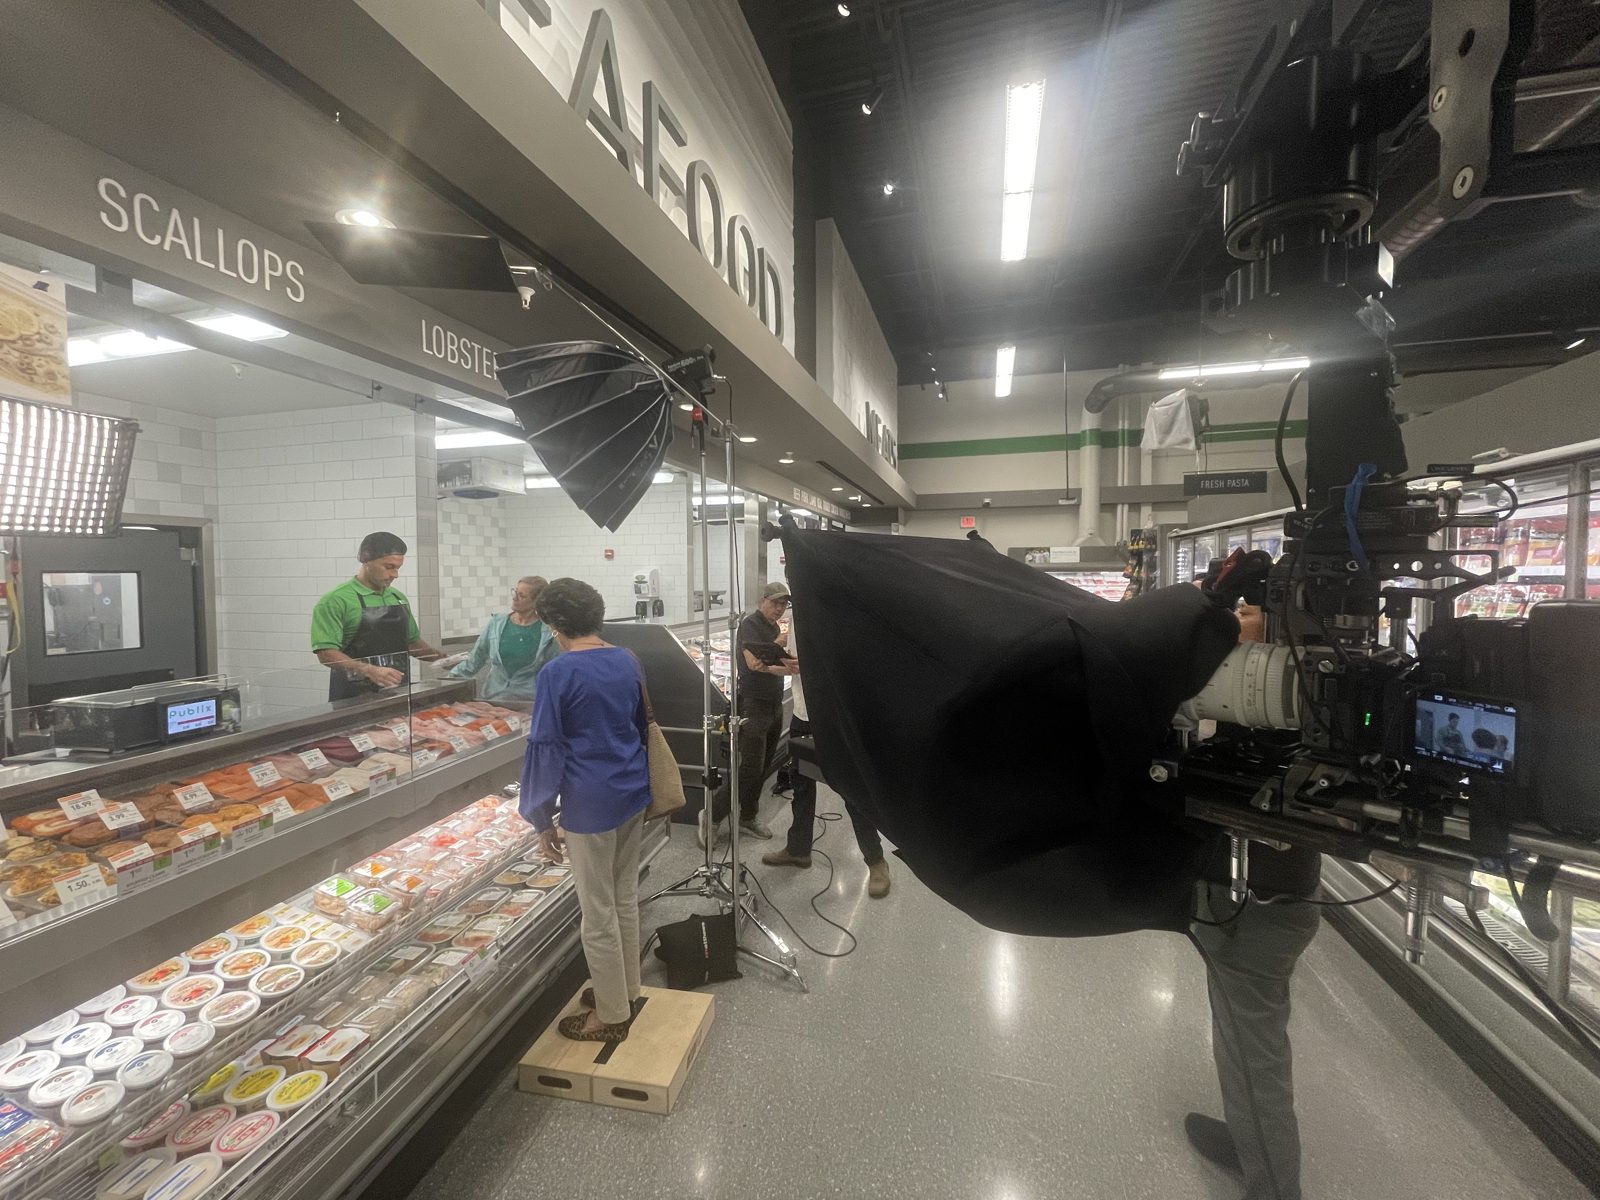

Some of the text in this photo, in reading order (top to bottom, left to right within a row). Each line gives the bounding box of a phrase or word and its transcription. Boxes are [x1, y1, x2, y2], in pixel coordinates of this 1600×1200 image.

[478, 0, 783, 346] AFOOD
[97, 177, 306, 304] SCALLOPS
[1200, 478, 1250, 489] FRESH PASTA
[66, 879, 88, 893] 1.50
